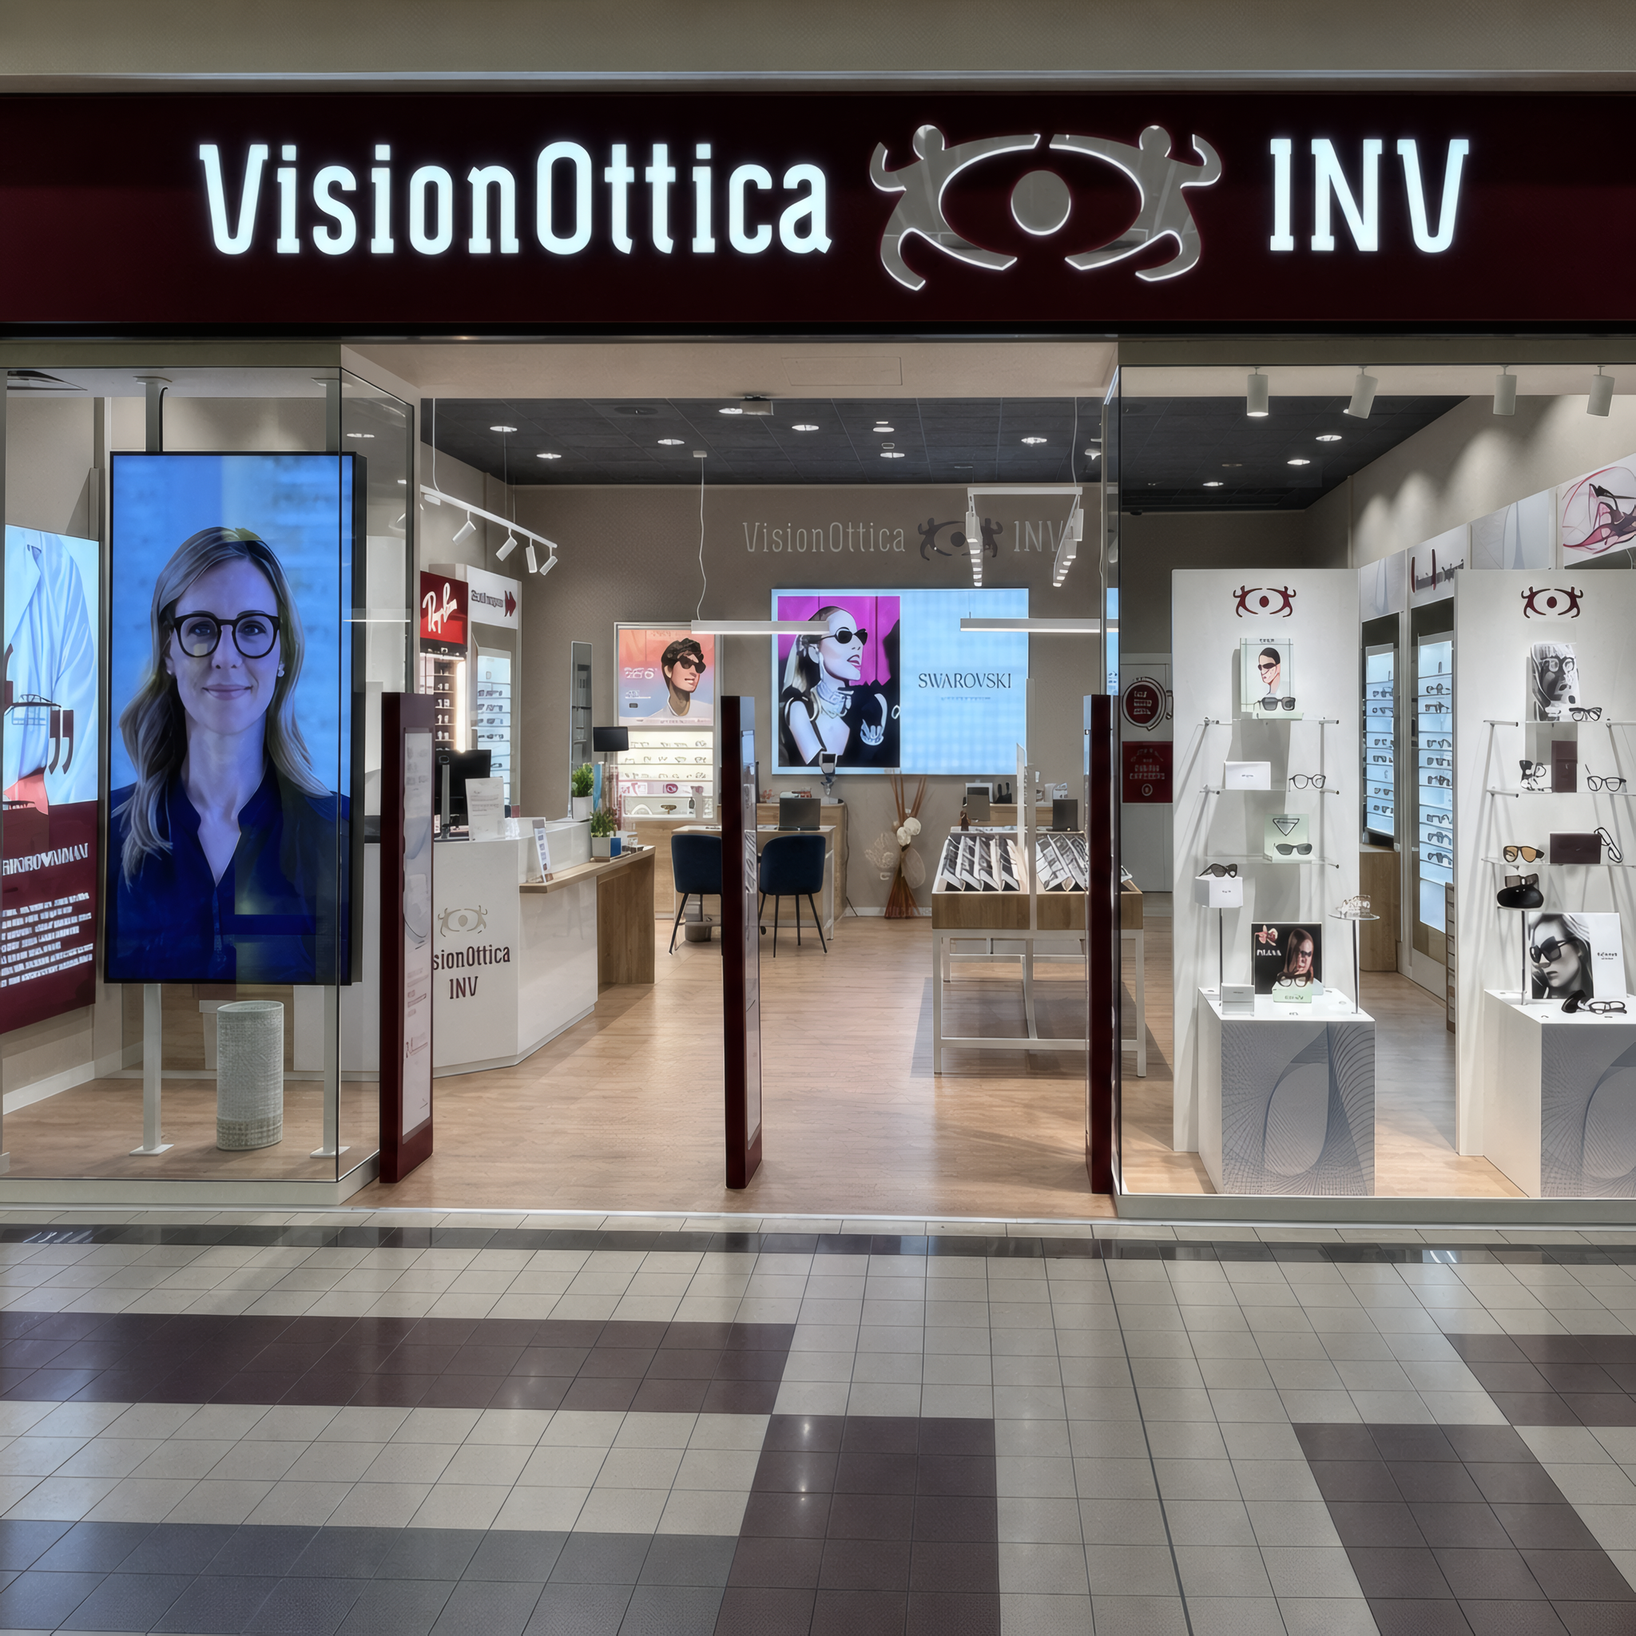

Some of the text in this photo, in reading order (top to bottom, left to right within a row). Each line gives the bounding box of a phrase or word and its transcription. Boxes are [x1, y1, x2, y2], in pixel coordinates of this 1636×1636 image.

[199, 138, 1470, 254] VisionOttica INV
[742, 520, 1066, 553] VisionOttica INV
[917, 672, 1012, 690] SWAROVSKI
[433, 944, 511, 971] sionOttica
[448, 975, 479, 1000] INV
